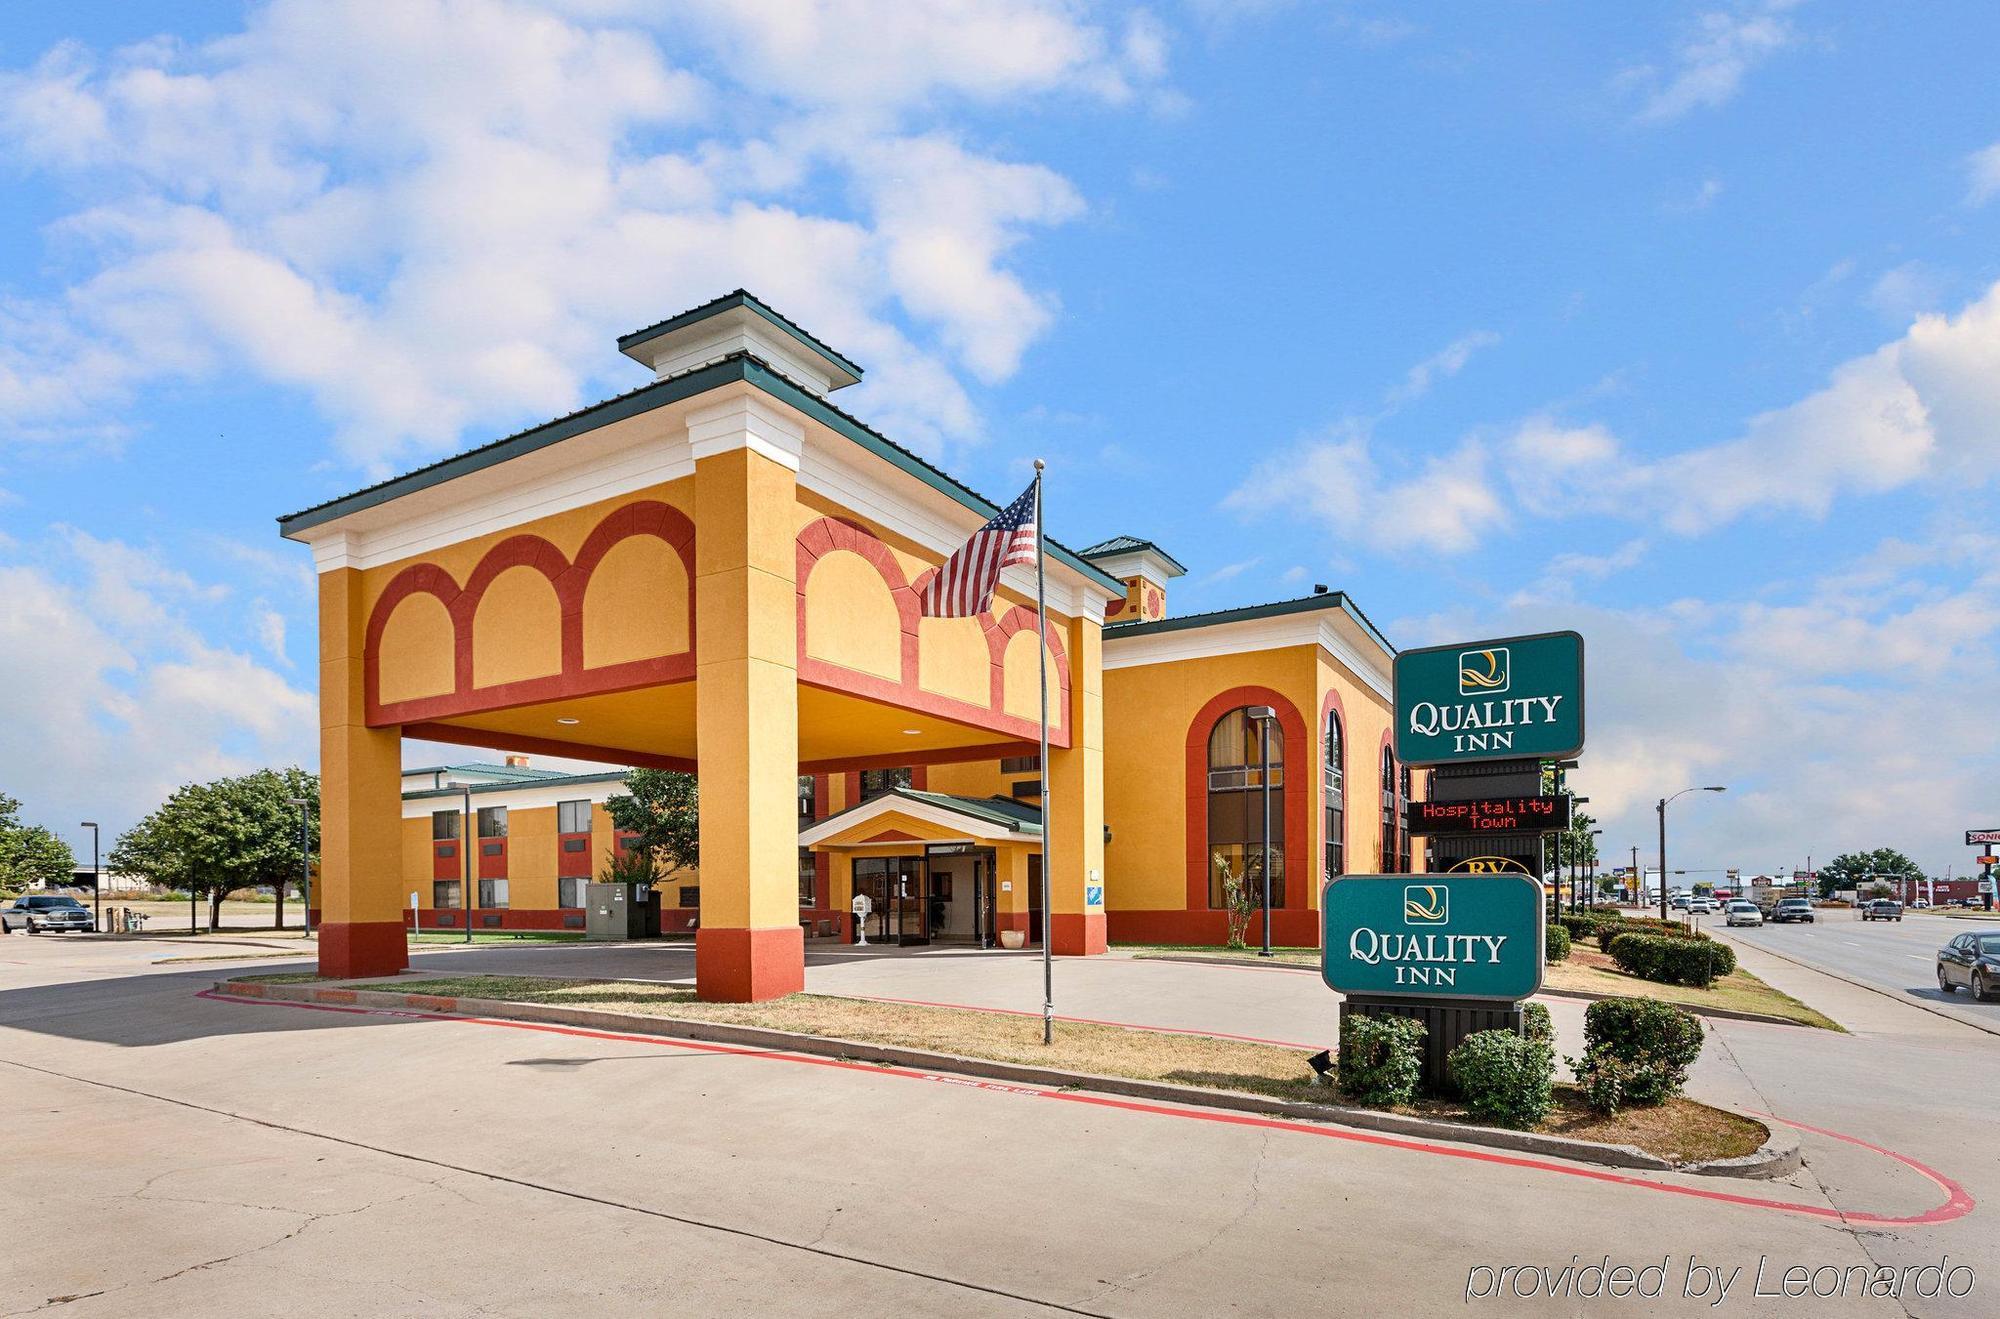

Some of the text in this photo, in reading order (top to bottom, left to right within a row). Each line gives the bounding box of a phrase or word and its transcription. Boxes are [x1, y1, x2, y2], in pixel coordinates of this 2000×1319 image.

[1410, 695, 1563, 737] QUALITY
[1454, 731, 1514, 752] INN
[1423, 800, 1553, 818] Hospitality
[1470, 815, 1517, 829] Town
[1350, 927, 1508, 965] QUALITY
[1395, 967, 1457, 986] INN
